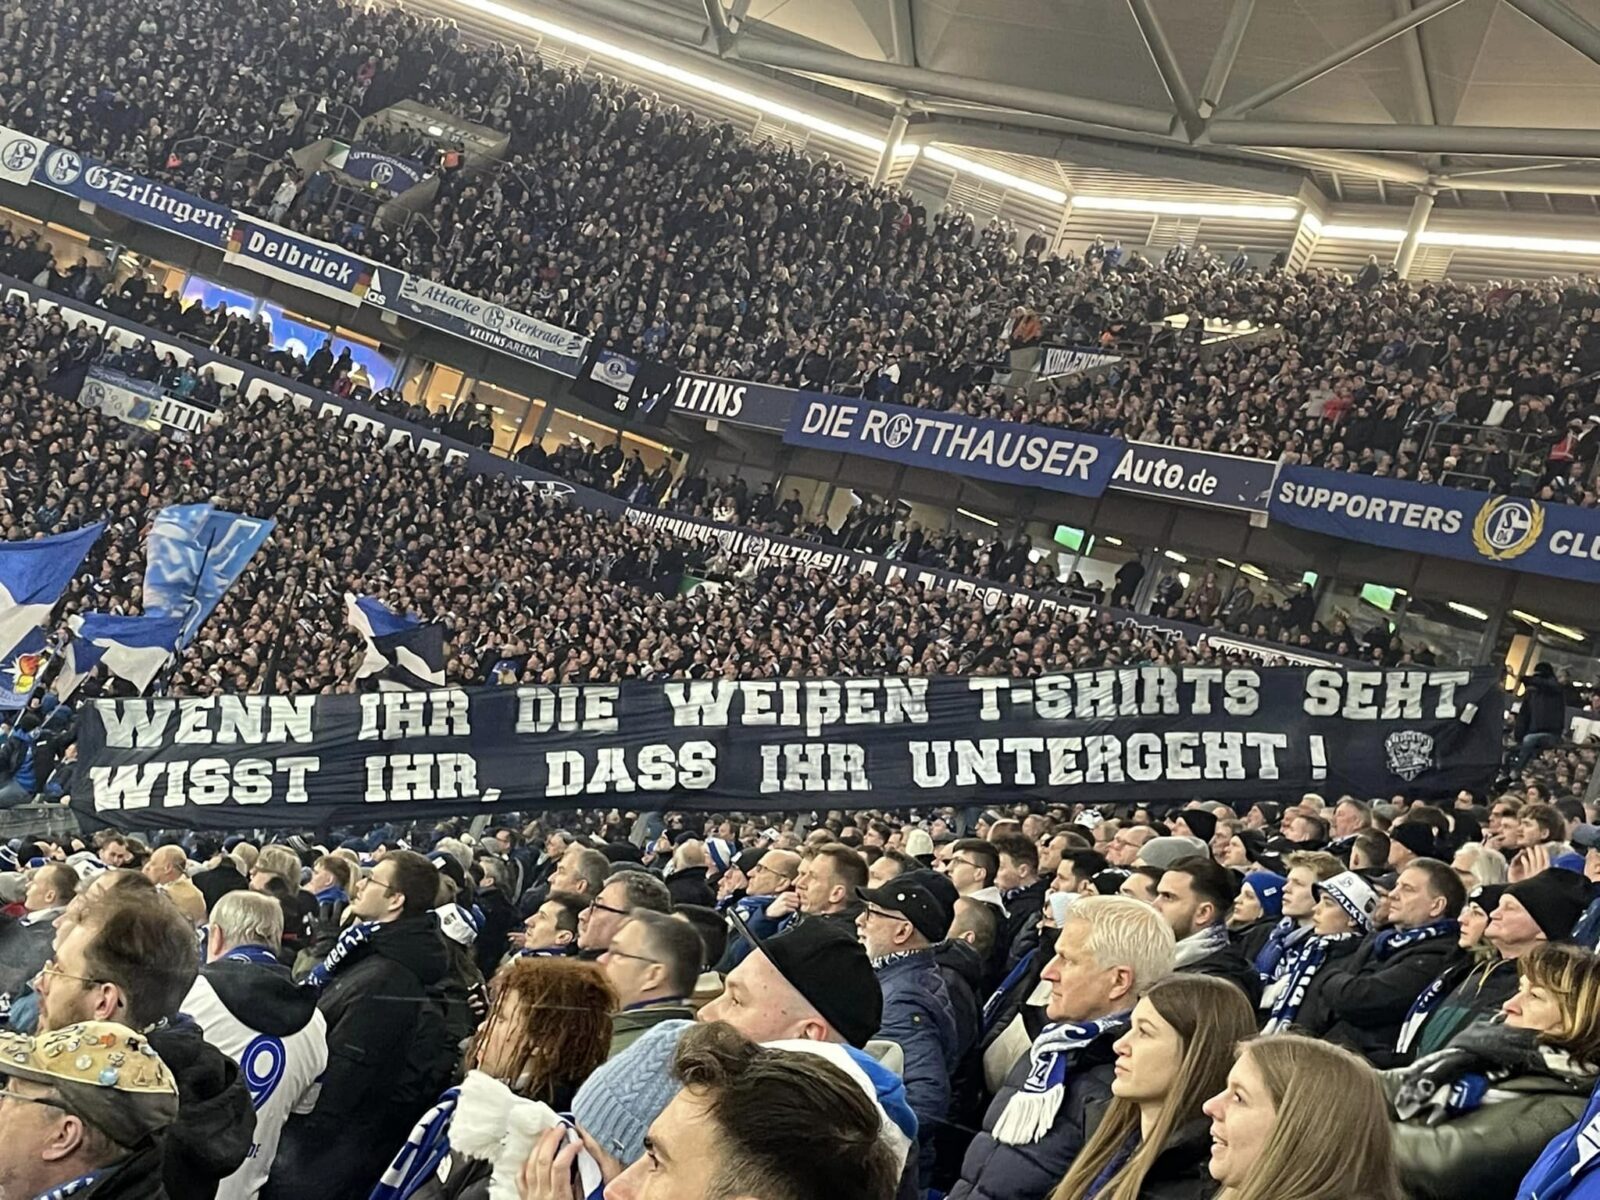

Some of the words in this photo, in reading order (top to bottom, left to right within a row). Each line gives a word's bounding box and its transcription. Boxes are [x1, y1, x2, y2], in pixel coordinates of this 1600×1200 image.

[247, 231, 354, 285] Delbrück
[422, 286, 481, 316] Attacke
[506, 316, 566, 348] Sterkrade
[469, 325, 505, 348] VELTINS
[505, 342, 540, 360] ARENA
[674, 376, 747, 417] LTINS
[801, 402, 859, 439] DIE
[1112, 449, 1218, 495] Auto.de
[1279, 481, 1463, 534] SUPPORTERS
[769, 541, 834, 568] ULTRAS
[94, 695, 316, 748] WENN
[358, 689, 471, 741] IHR
[515, 686, 620, 734] DIE
[663, 678, 929, 736] WEIßEN
[968, 667, 1261, 721] T-SHIRTS
[1303, 668, 1479, 724] SEHT,
[89, 757, 319, 812] WISST
[544, 740, 717, 797] DASS
[760, 743, 873, 794] IHR
[908, 731, 1287, 789] UNTERGEHT
